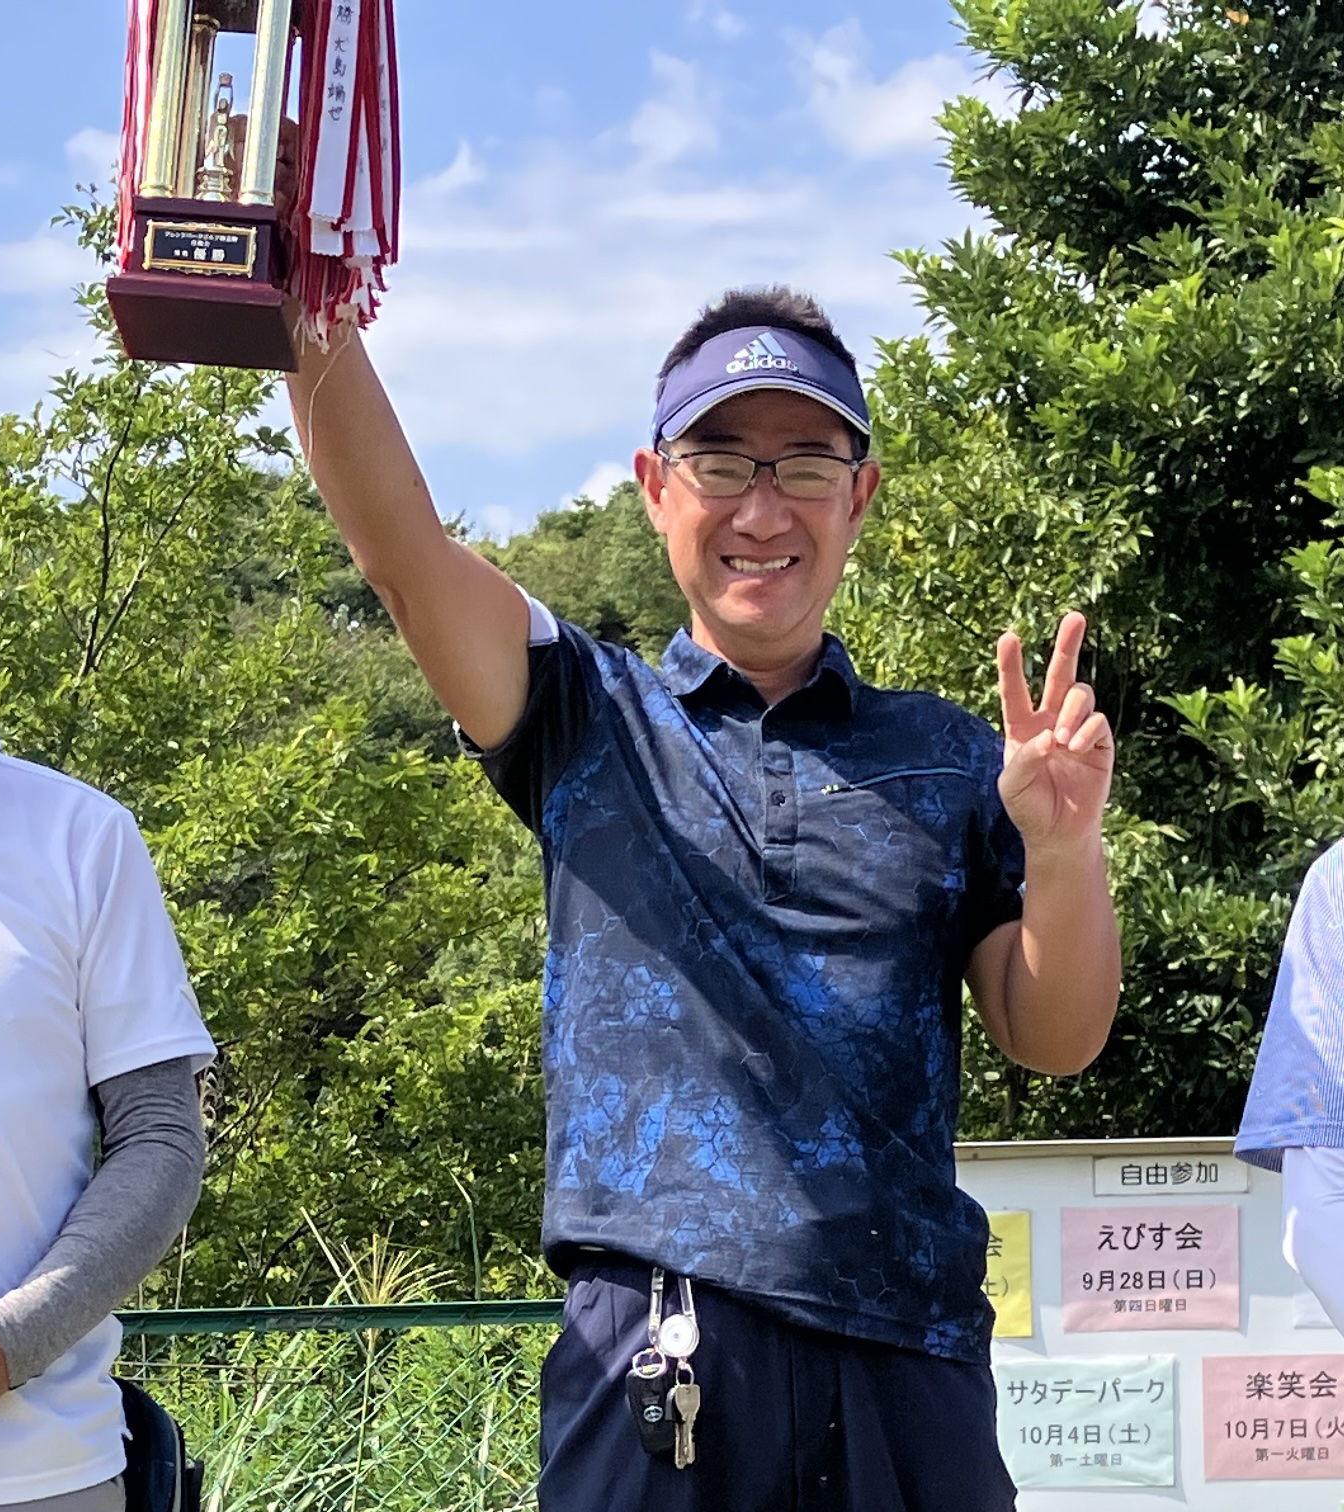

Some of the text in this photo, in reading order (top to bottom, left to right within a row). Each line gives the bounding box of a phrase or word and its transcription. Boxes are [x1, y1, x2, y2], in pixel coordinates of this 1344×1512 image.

[1120, 1161, 1219, 1186] 自由参加
[1097, 1222, 1204, 1251] えびす会
[1113, 1298, 1188, 1314] 第四日曜日
[1006, 1376, 1167, 1406] サタデーパーク
[1245, 1370, 1339, 1400] 楽笑会
[1049, 1452, 1123, 1468] 第一土曜日
[1254, 1446, 1330, 1462] 第一火曜日
